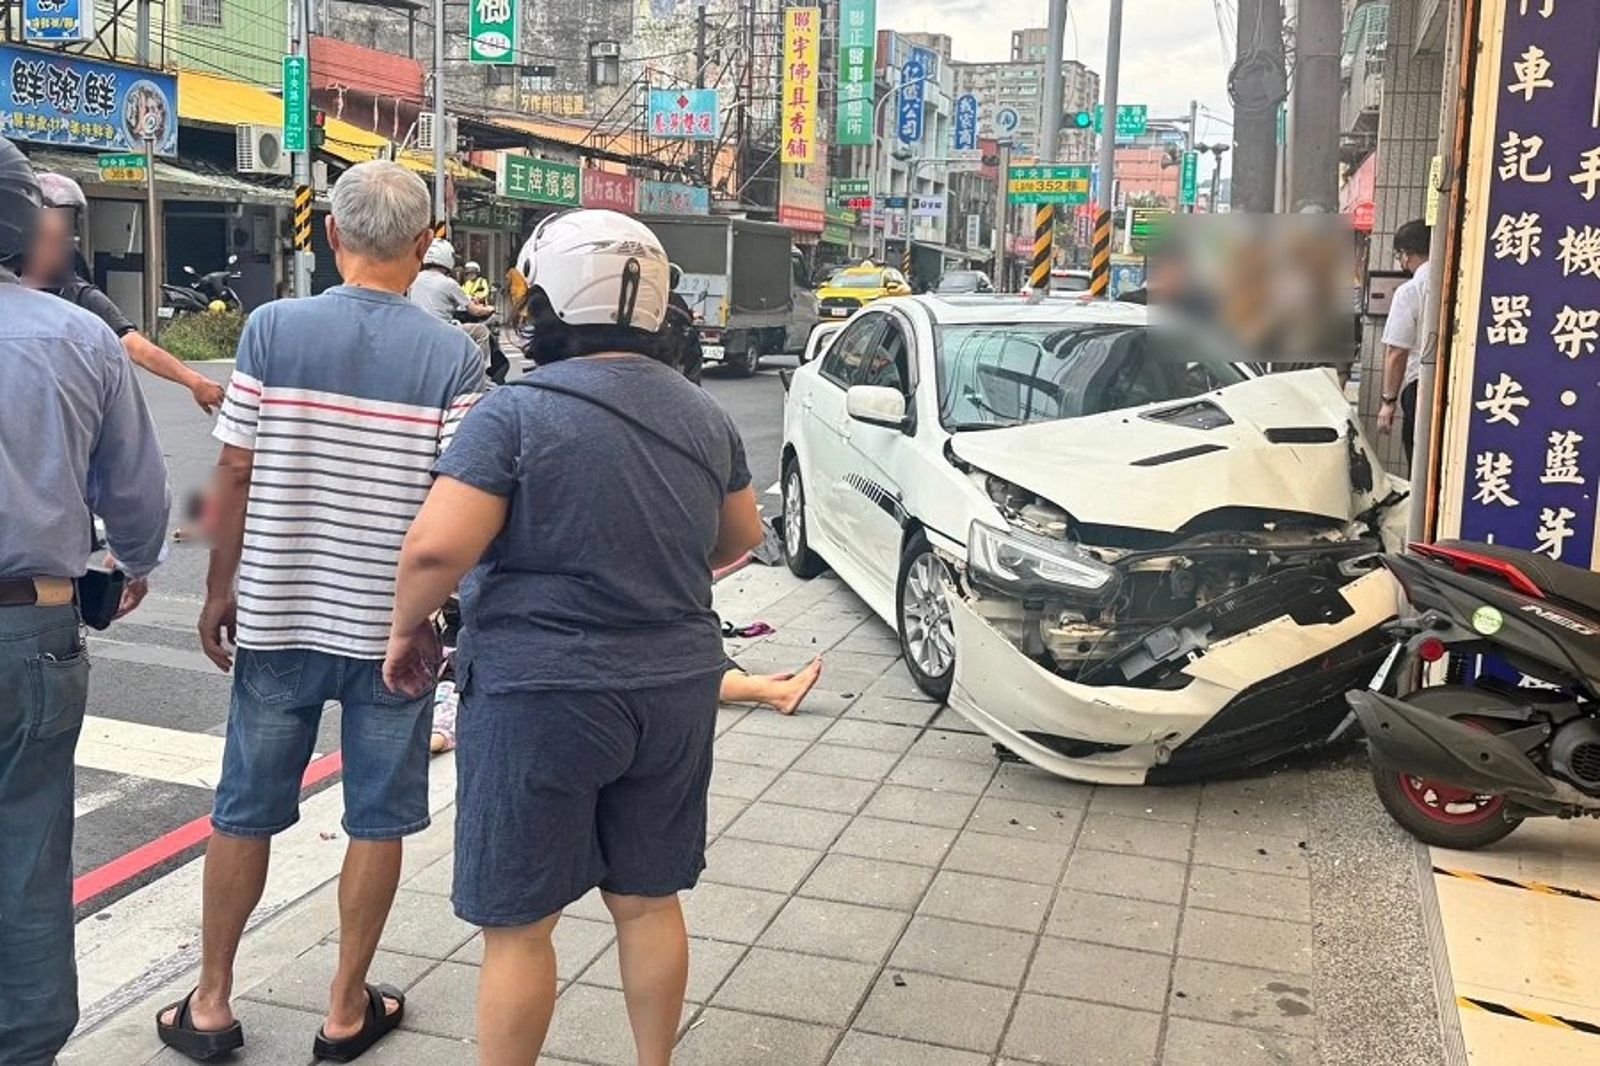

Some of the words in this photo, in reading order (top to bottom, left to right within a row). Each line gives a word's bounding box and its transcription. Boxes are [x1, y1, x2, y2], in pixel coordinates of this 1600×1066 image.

[11, 58, 116, 119] 鮮粥鮮
[510, 163, 576, 200] 王牌檳榔
[1014, 168, 1080, 179] 中央路一段
